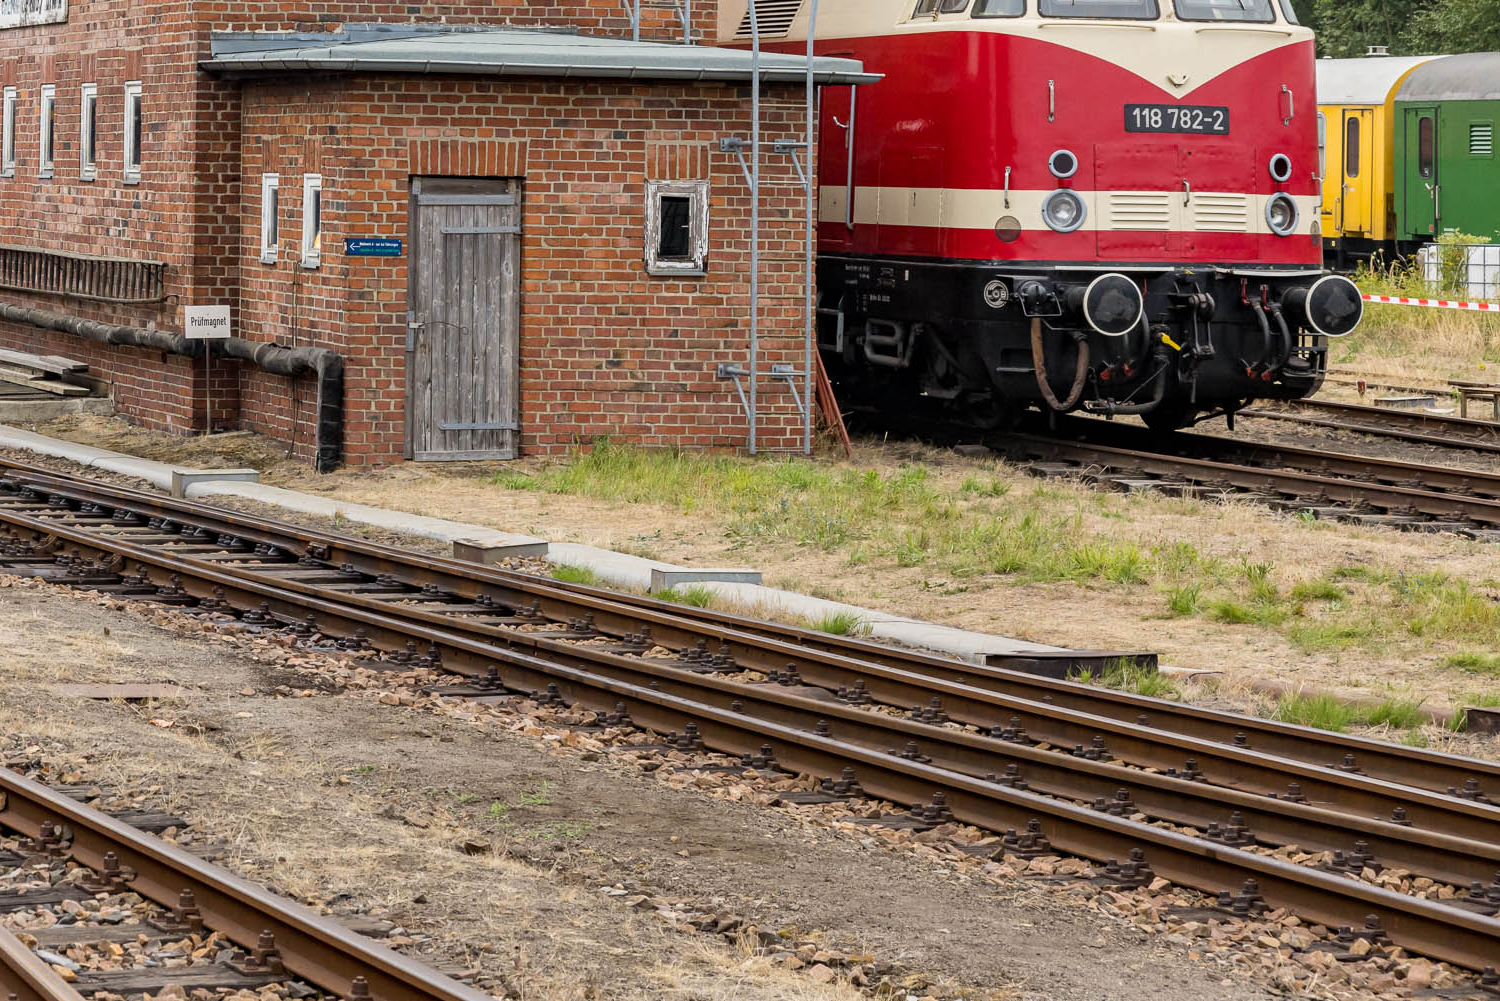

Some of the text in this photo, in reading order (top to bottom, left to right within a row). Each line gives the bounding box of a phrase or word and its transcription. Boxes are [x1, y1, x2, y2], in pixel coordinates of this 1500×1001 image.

[1133, 108, 1224, 130] 118 782-2
[191, 316, 227, 328] Prüfmagnet
